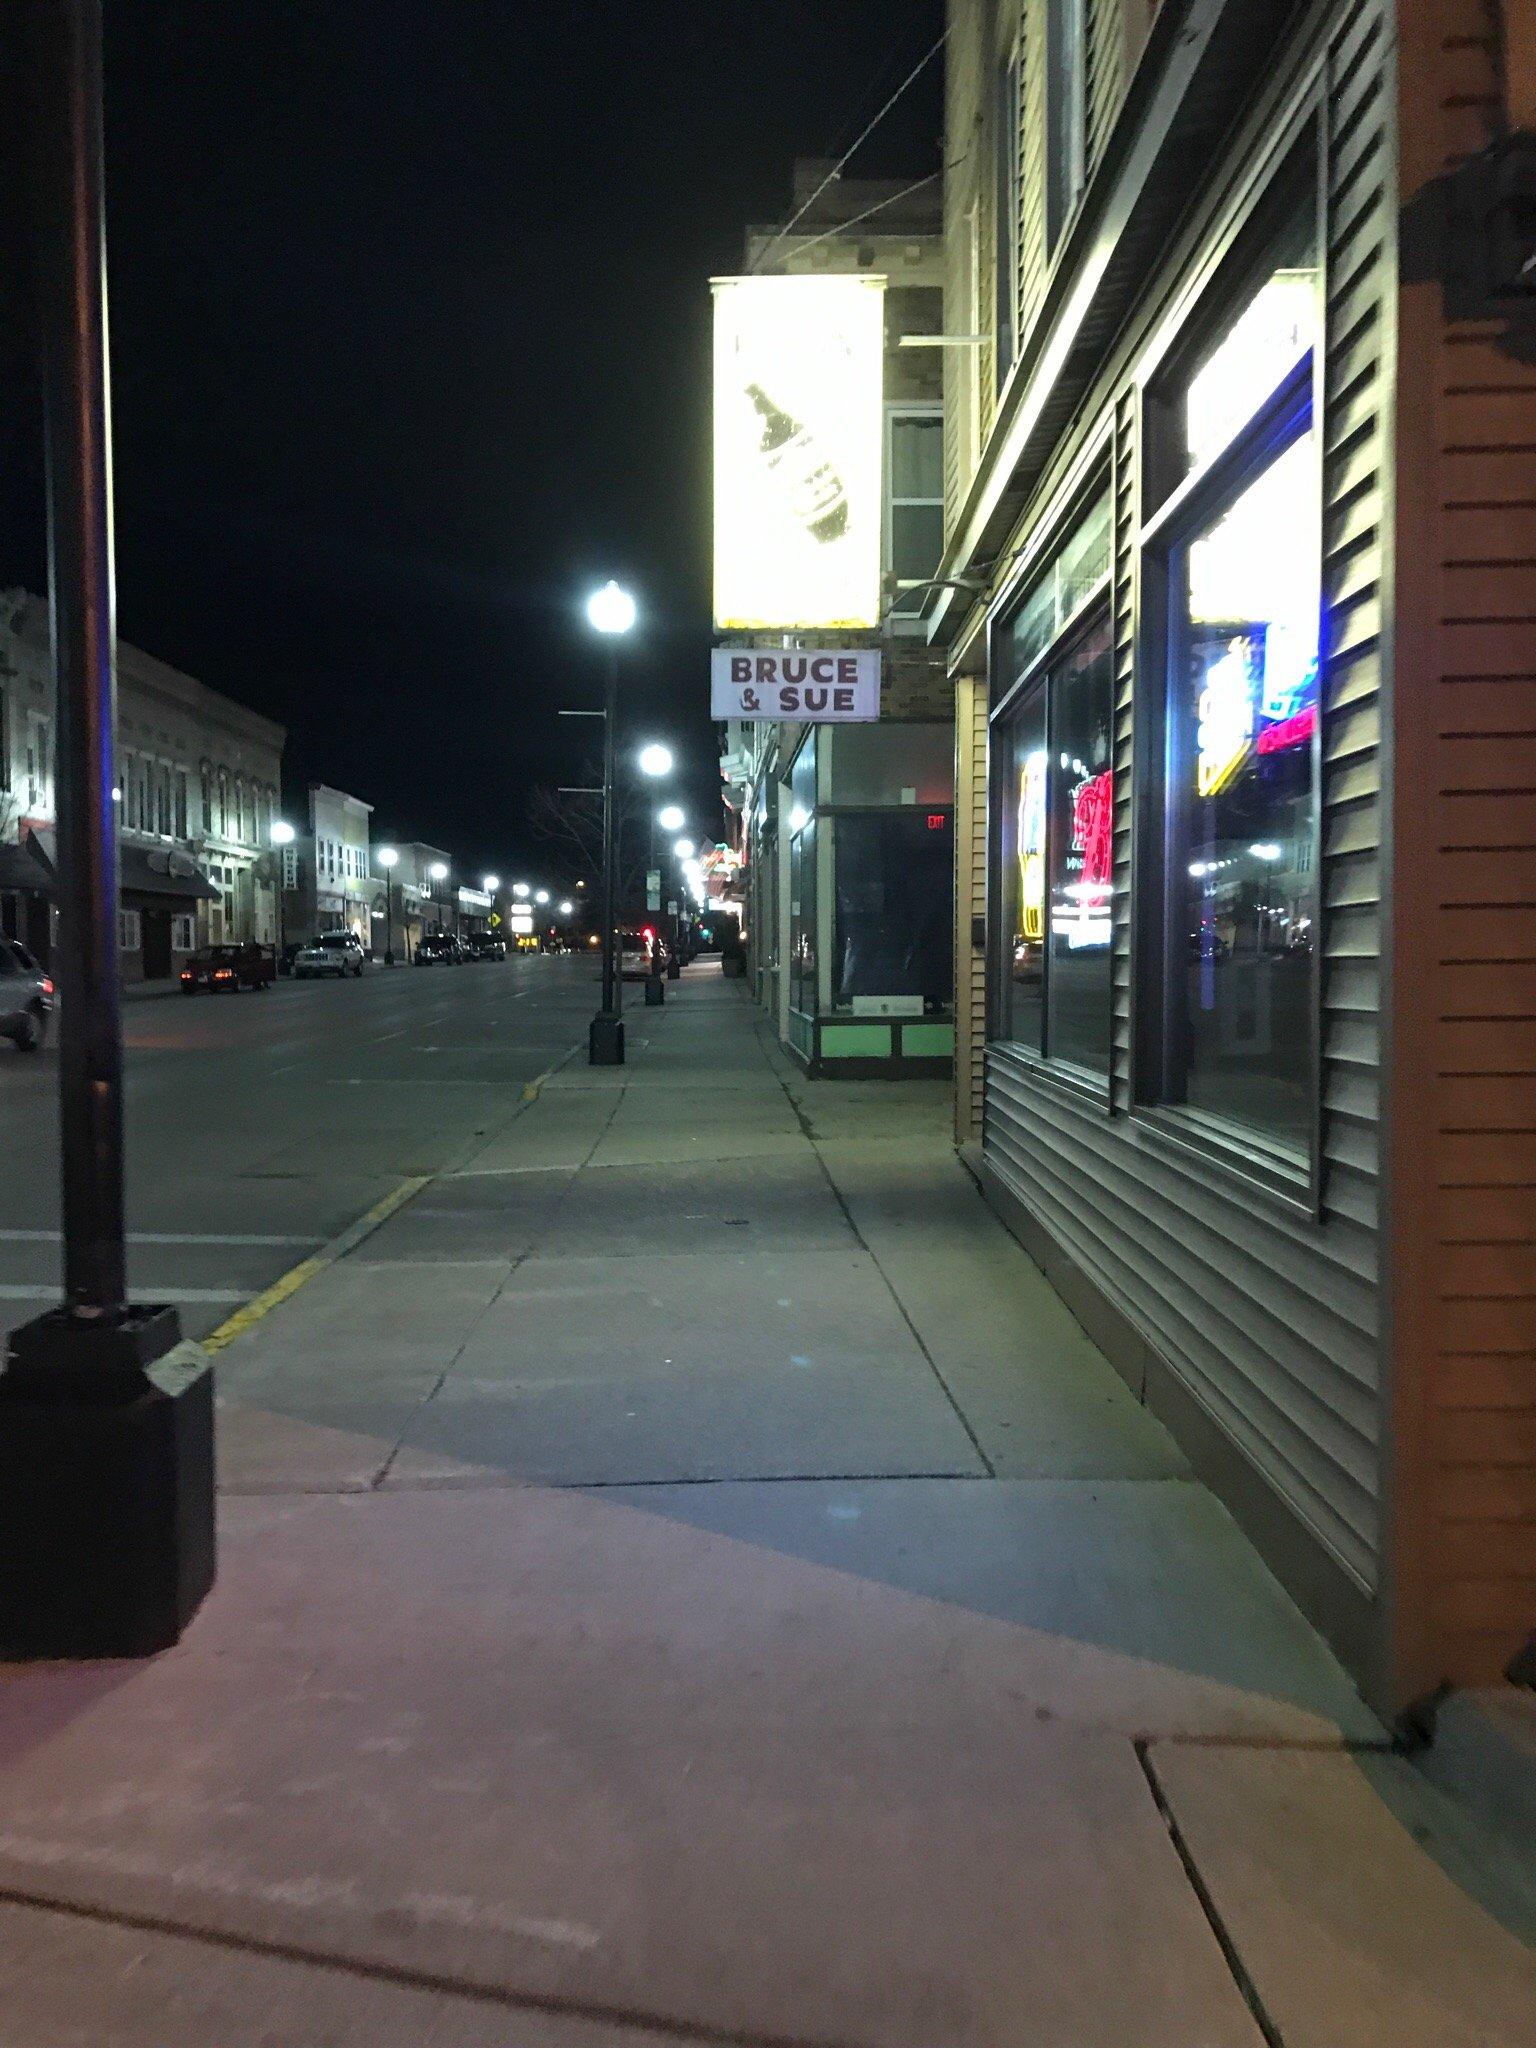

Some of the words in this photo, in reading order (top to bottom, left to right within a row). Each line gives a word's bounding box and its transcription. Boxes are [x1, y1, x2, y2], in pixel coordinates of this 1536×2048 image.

[731, 657, 858, 683] BRUCE
[740, 687, 760, 711] &
[779, 686, 855, 711] SUE
[928, 815, 945, 829] EXIT
